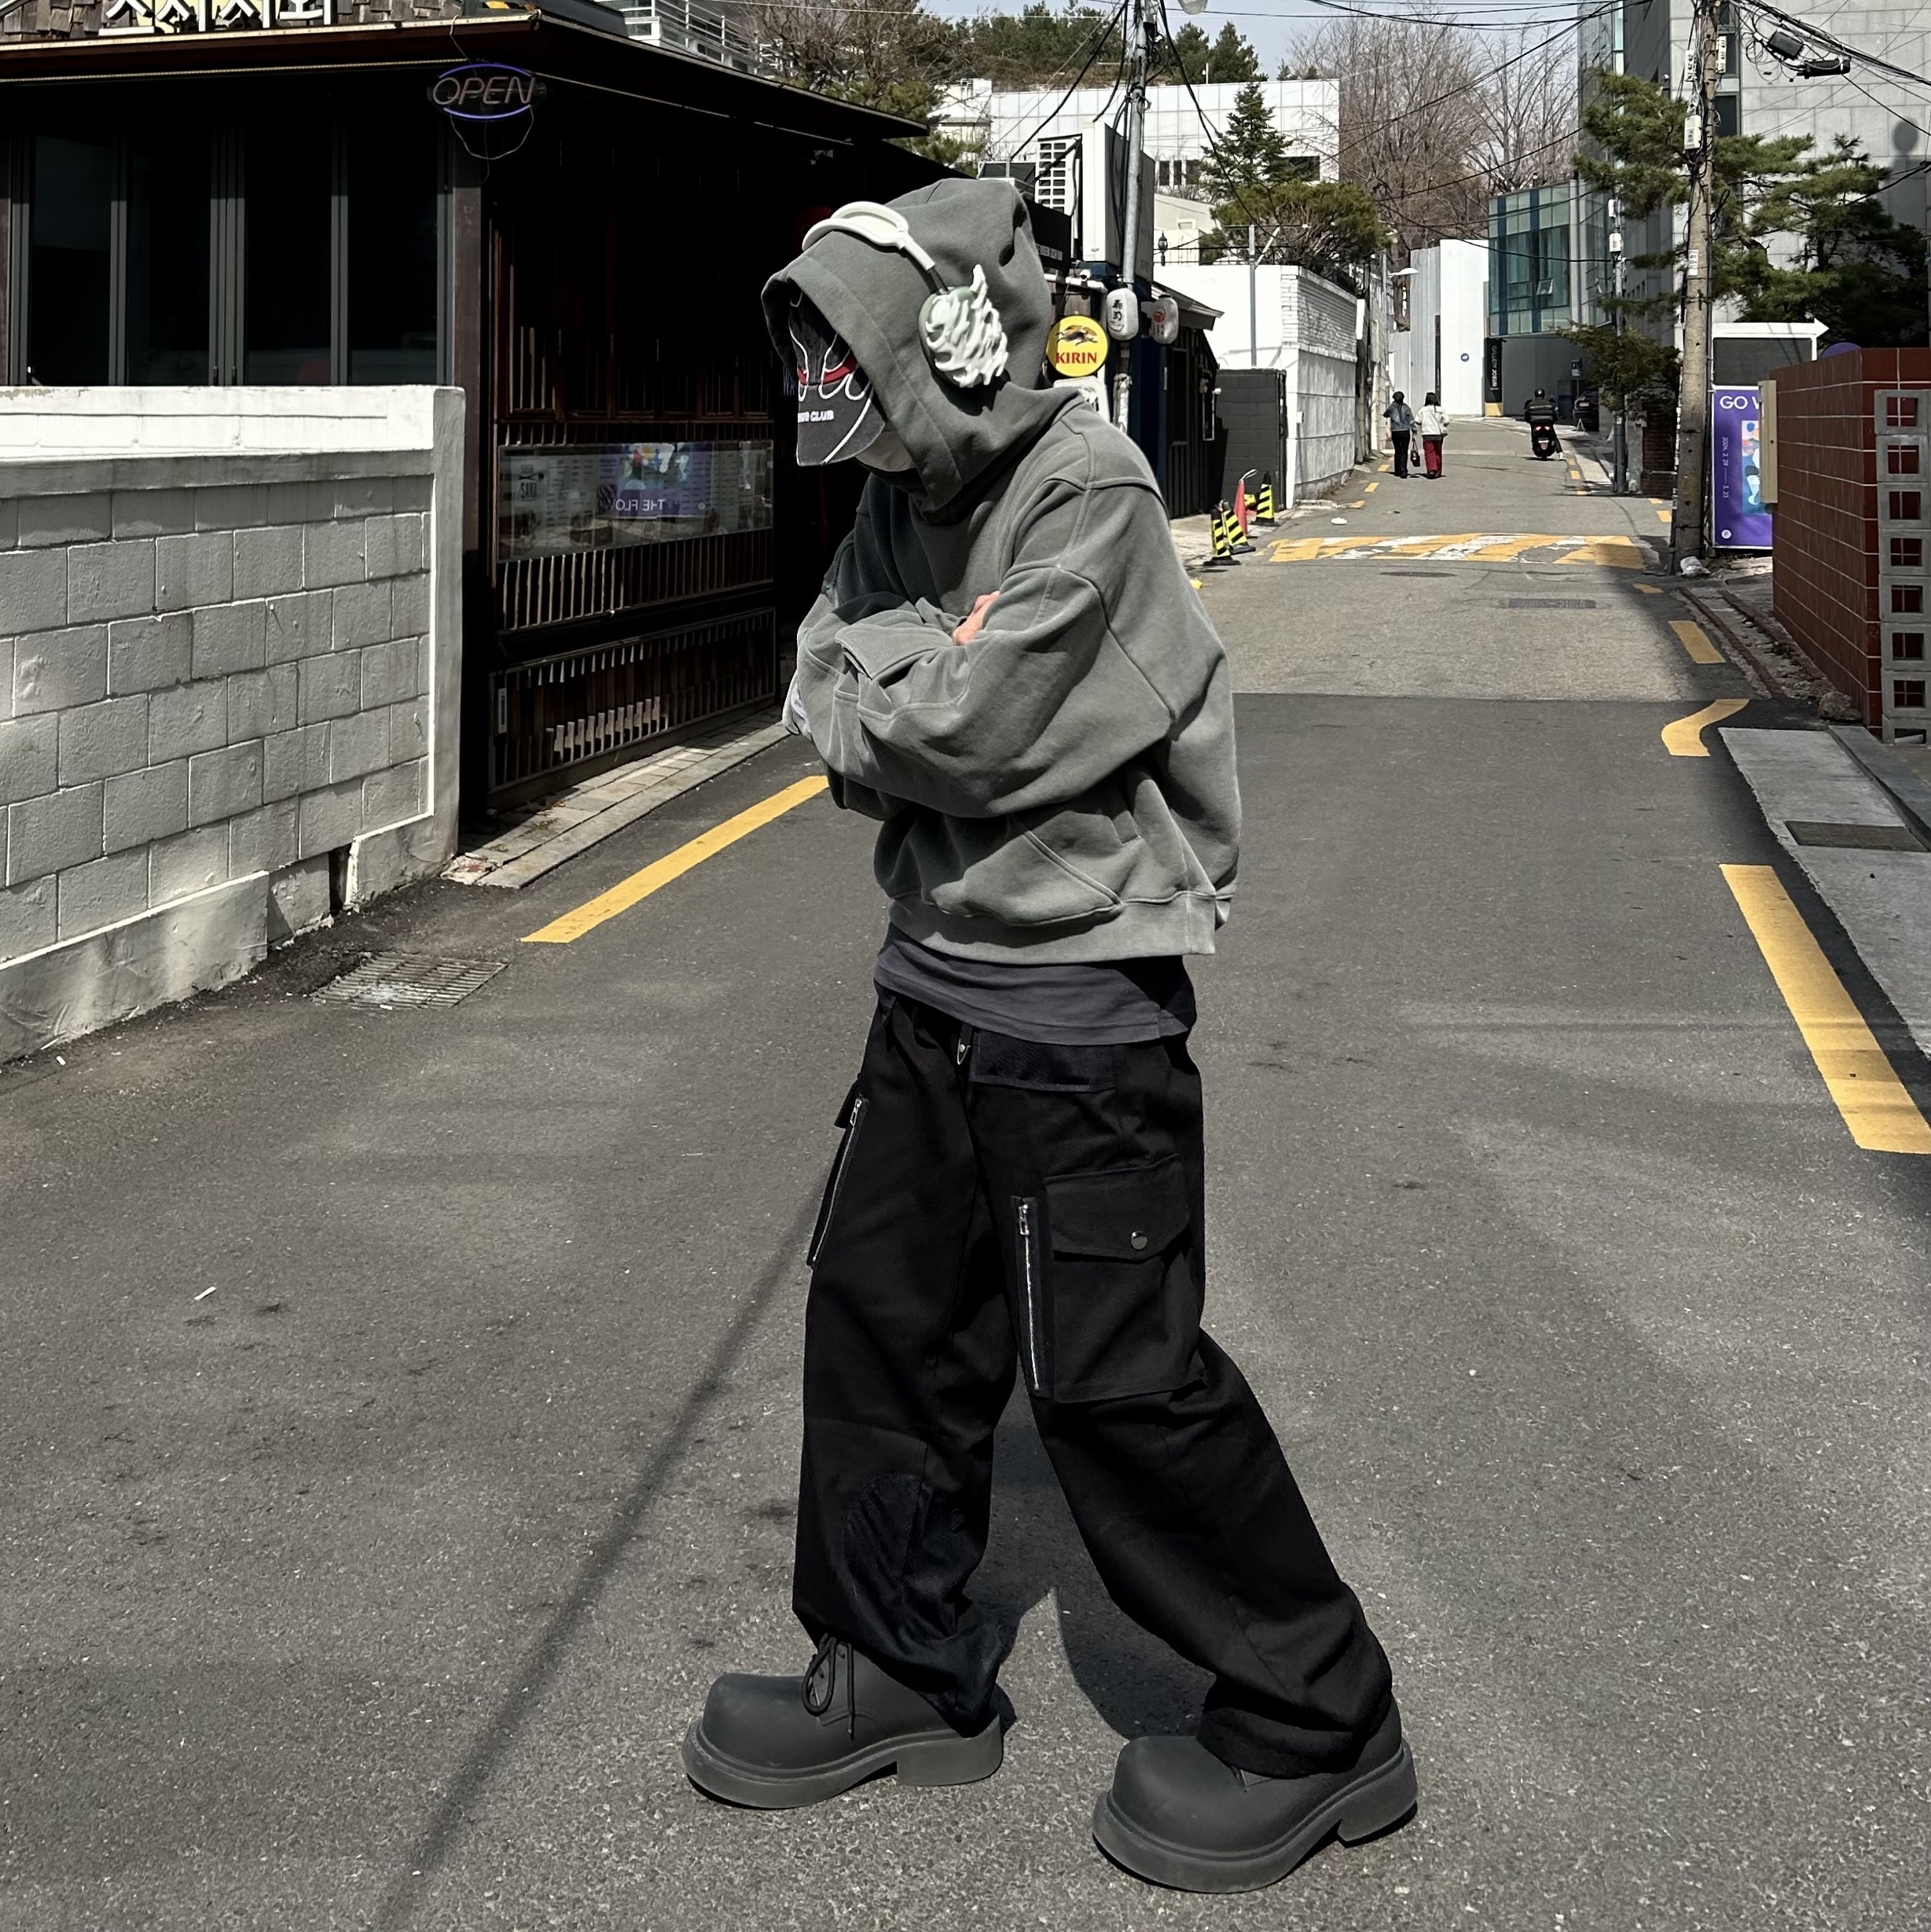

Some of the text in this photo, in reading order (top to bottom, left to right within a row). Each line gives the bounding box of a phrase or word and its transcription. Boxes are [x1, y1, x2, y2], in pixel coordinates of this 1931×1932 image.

[433, 76, 536, 105] OPEN
[1055, 351, 1097, 364] KIRIN
[1720, 395, 1749, 410] GO
